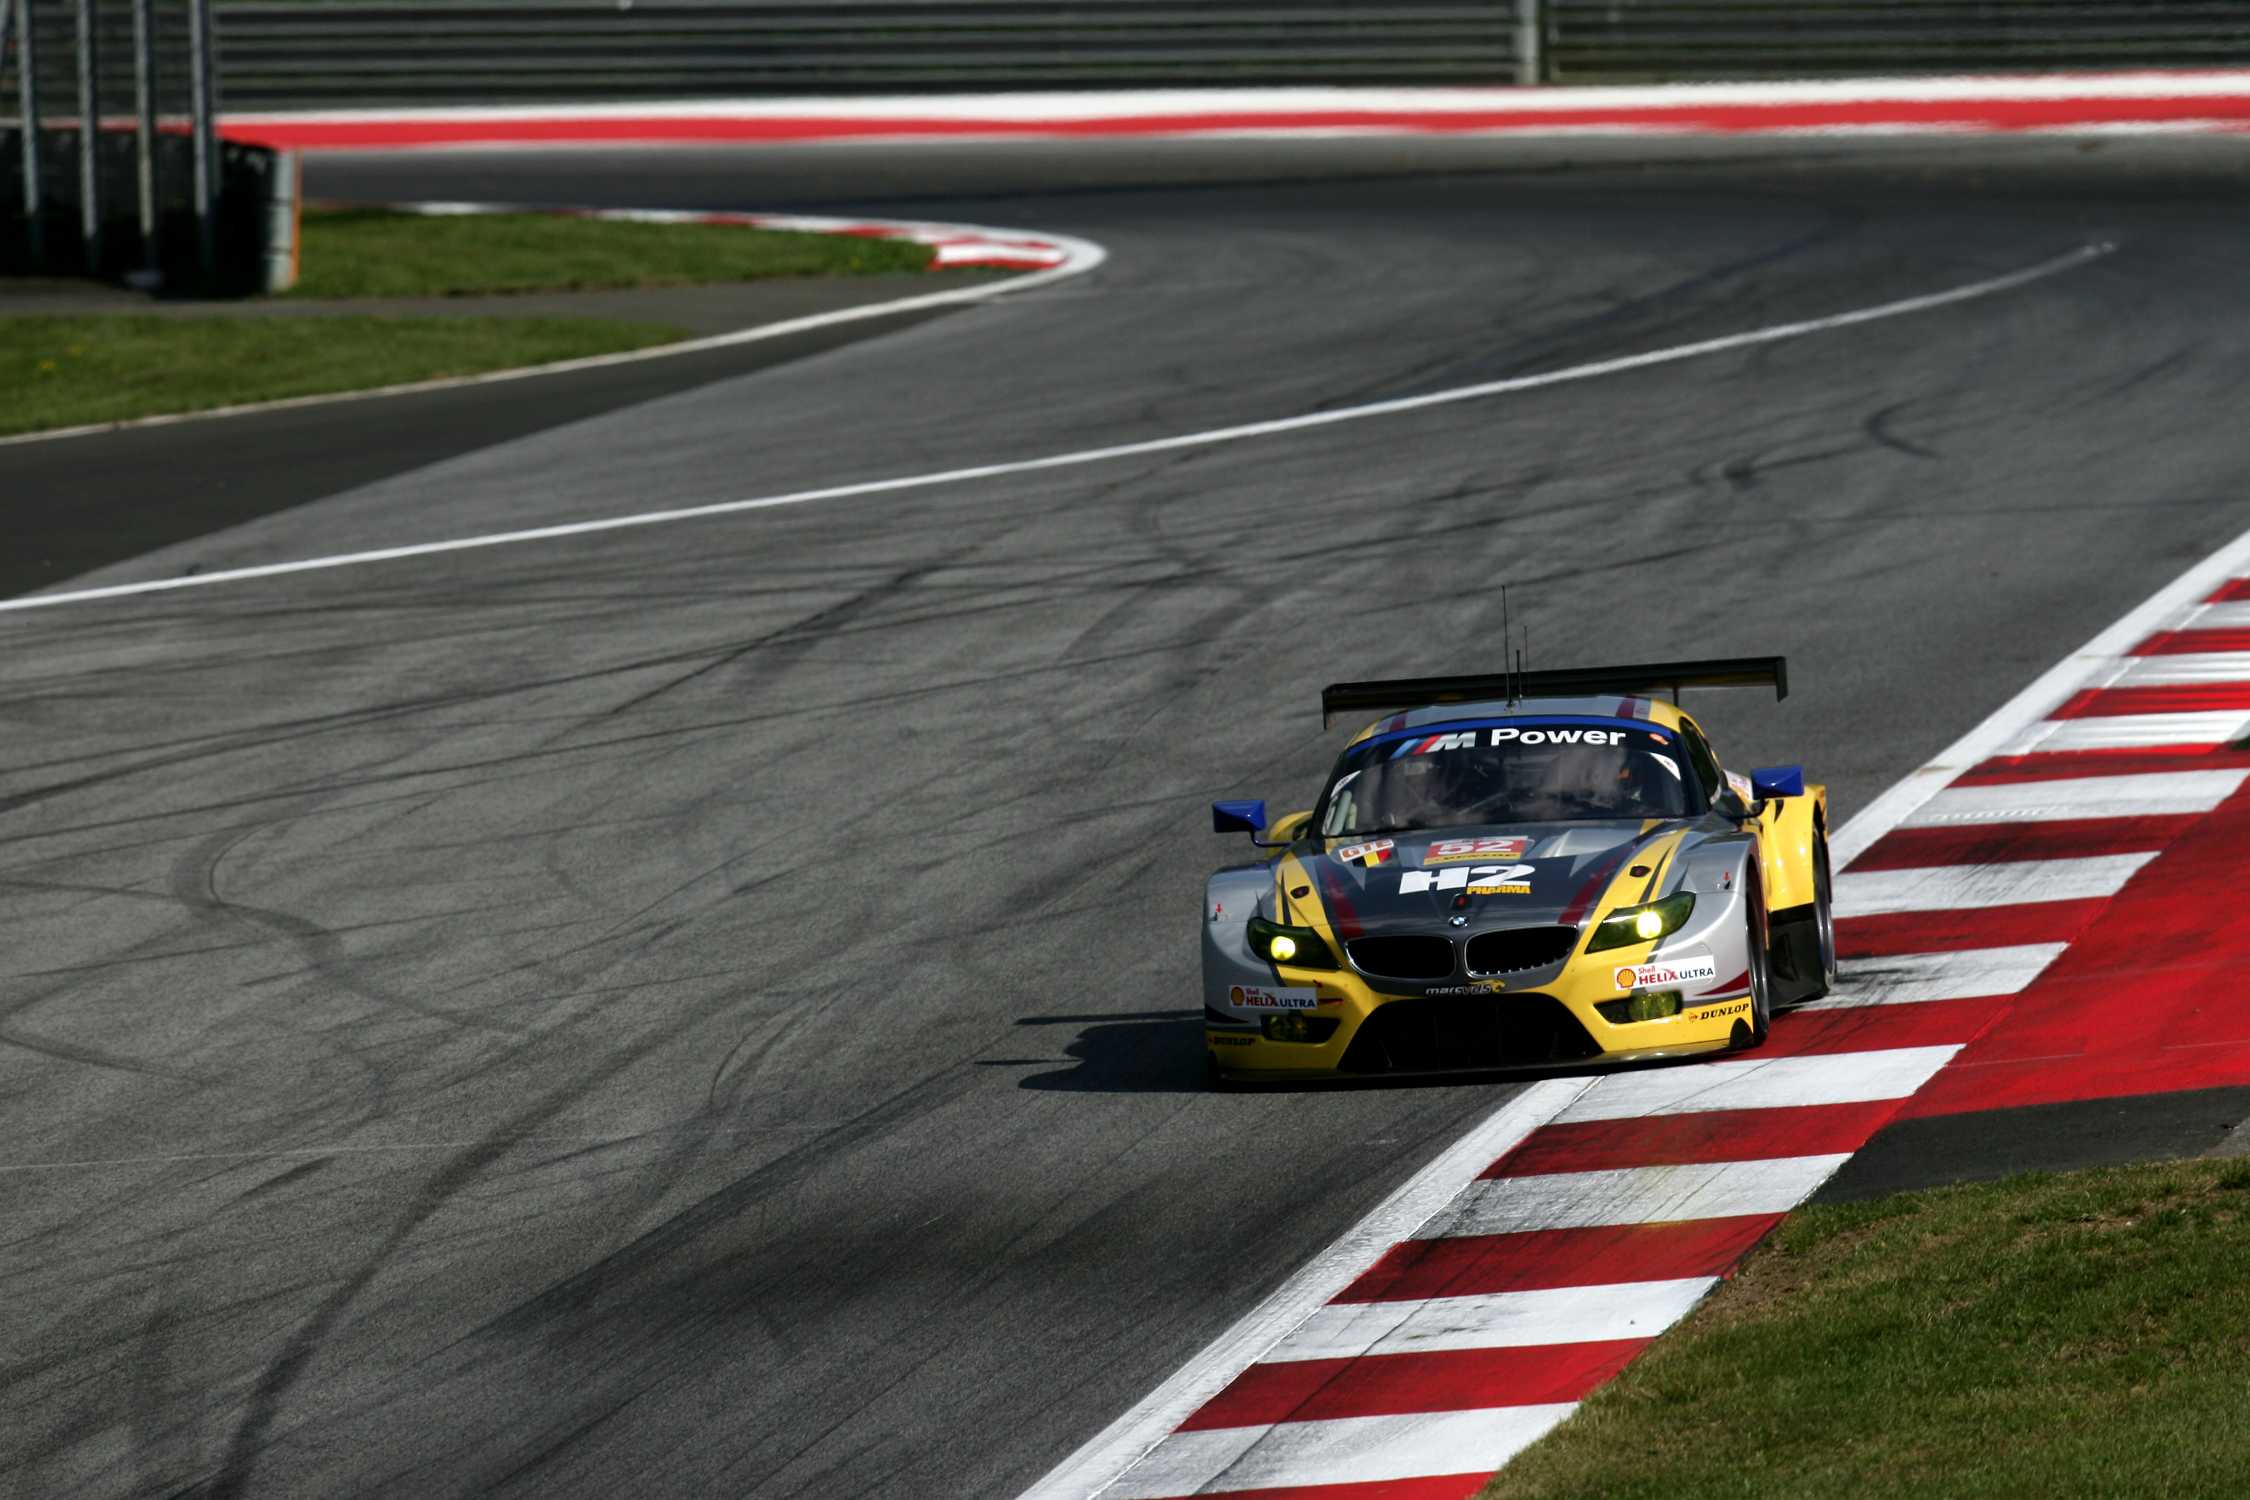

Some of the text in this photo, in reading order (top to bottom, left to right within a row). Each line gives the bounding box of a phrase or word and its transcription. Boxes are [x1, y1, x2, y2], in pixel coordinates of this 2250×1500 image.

[1491, 728, 1626, 746] Power
[1437, 839, 1515, 855] 52
[1399, 864, 1536, 895] H2
[1466, 885, 1532, 895] PHARMA
[1638, 967, 1656, 975] Shell
[1639, 967, 1714, 985] HELIX ULTRA
[1246, 997, 1316, 1008] HELIX ULTRA
[1700, 1003, 1750, 1021] DUNLOP
